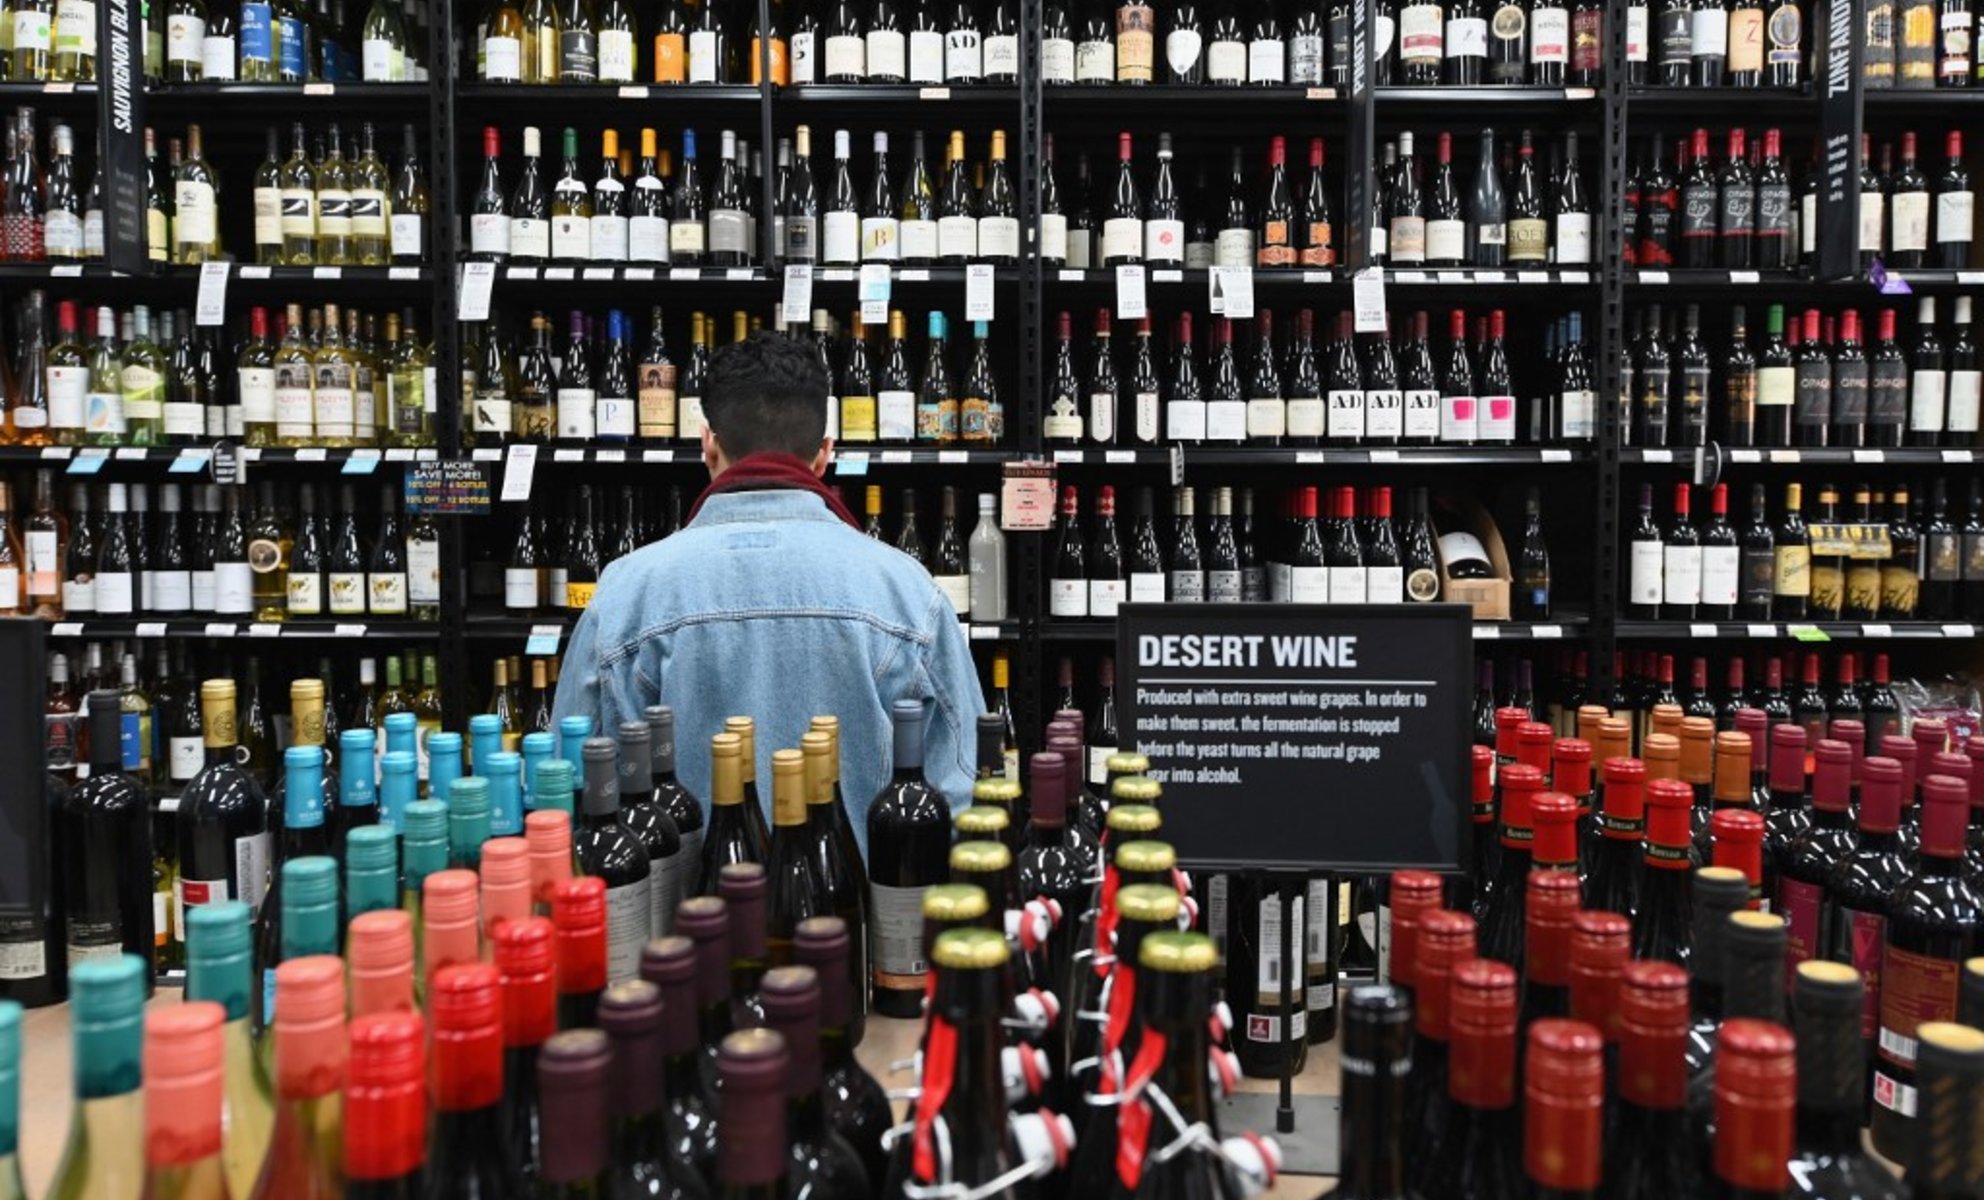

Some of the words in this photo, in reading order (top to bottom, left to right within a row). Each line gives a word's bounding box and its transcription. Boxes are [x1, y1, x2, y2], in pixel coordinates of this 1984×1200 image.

[1352, 30, 1366, 96] PINOT
[110, 29, 133, 134] SAUVIGNON
[414, 469, 442, 479] SAVE
[444, 470, 482, 480] MORE!
[420, 461, 441, 470] BUY
[443, 461, 475, 470] MORE
[1138, 634, 1264, 668] DESERT
[1271, 635, 1358, 668] WINE
[1136, 688, 1193, 705] Produced
[1194, 689, 1219, 705] with
[1221, 691, 1251, 705] extra
[1253, 692, 1287, 706] sweet
[1290, 690, 1318, 706] wine
[1319, 693, 1364, 710] grapes.
[1365, 690, 1378, 706] In
[1379, 691, 1412, 707] order
[1414, 693, 1427, 707] to
[1136, 714, 1168, 731] make
[1170, 715, 1199, 731] them
[1202, 717, 1240, 732] sweet,
[1241, 716, 1260, 732] the
[1262, 716, 1337, 733] fermentation
[1339, 717, 1350, 733] is
[1352, 716, 1400, 736] stopped
[1136, 740, 1174, 757] before
[1176, 741, 1195, 757] the
[1197, 743, 1229, 760] yeast
[1230, 743, 1262, 758] turns
[1264, 741, 1279, 758] all
[1280, 741, 1299, 758] the
[1301, 742, 1345, 759] natural
[1346, 745, 1381, 763] grape
[1137, 768, 1170, 783] ugar
[1171, 767, 1194, 783] into
[1196, 767, 1242, 783] alcohol.
